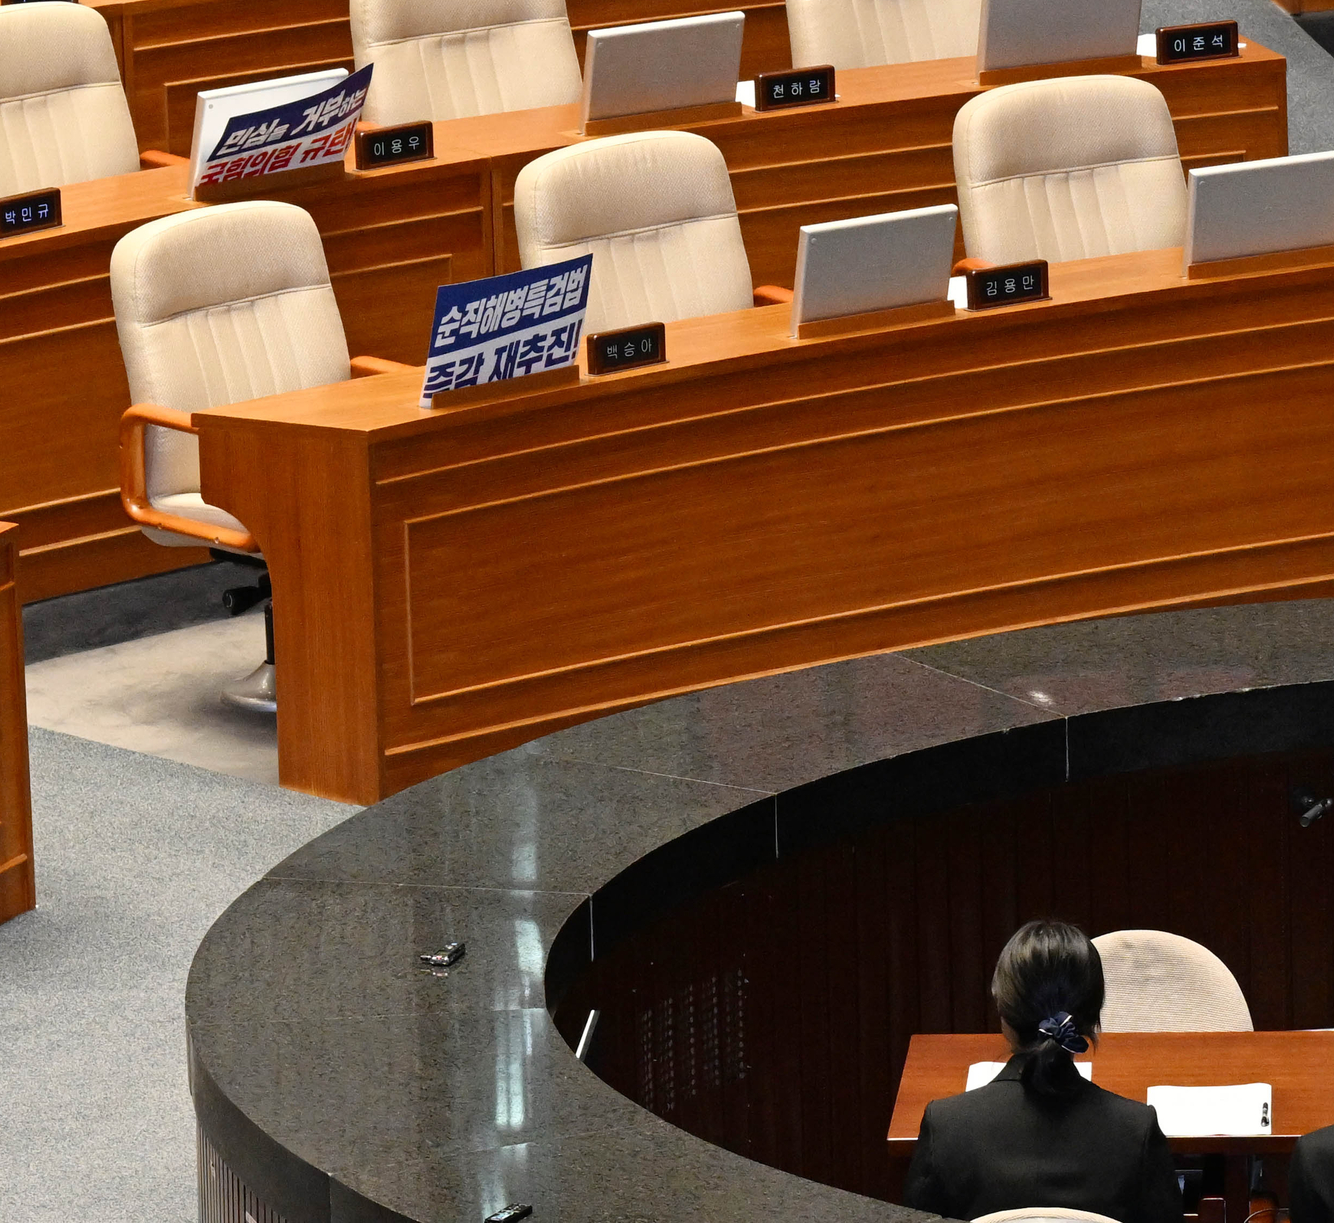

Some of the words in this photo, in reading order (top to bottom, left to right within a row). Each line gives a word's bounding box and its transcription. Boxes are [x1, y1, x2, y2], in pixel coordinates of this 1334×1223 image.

[1174, 35, 1224, 52] 이준석
[773, 79, 821, 99] 천하람
[216, 118, 290, 156] 민심을
[290, 87, 367, 136] 거부하는
[374, 136, 419, 156] 이용우
[5, 203, 49, 224] 박민규
[986, 275, 1034, 296] 김용만
[434, 264, 588, 348] 순직해병특검법
[488, 318, 583, 382] 재추진!
[607, 339, 652, 358] 백승아
